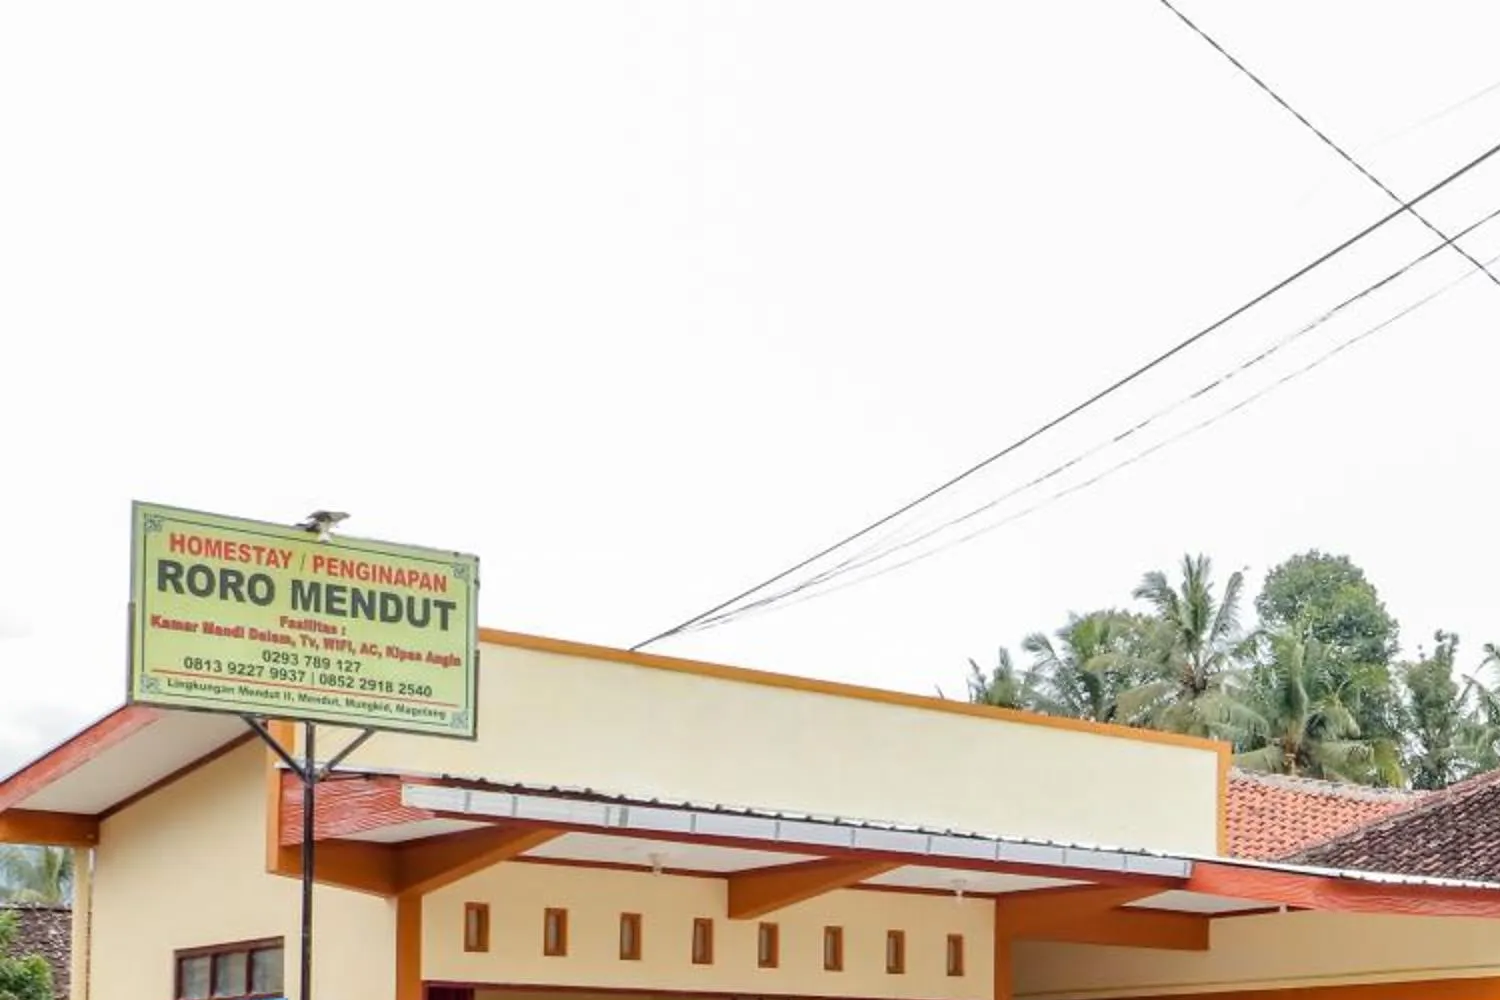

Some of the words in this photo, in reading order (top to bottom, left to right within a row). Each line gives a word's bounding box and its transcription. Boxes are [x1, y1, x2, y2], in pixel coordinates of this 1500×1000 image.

[169, 532, 293, 569] HOMESTAY
[300, 552, 306, 572] /
[313, 554, 447, 593] PENGINAPAN
[157, 559, 276, 607] RORO
[291, 579, 457, 631] MENDUT
[150, 613, 198, 633] Kamar
[202, 620, 245, 640] Mandi
[183, 655, 223, 673] 0813
[227, 661, 265, 678] 9227
[269, 667, 306, 683] 9937
[319, 671, 355, 689] 0852
[359, 677, 394, 694] 2918
[399, 682, 433, 698] 2540
[262, 649, 300, 666] 0293
[304, 654, 331, 670] 789
[336, 658, 362, 673] 127
[167, 677, 235, 696] Lingkungan
[238, 685, 280, 700] Mendut
